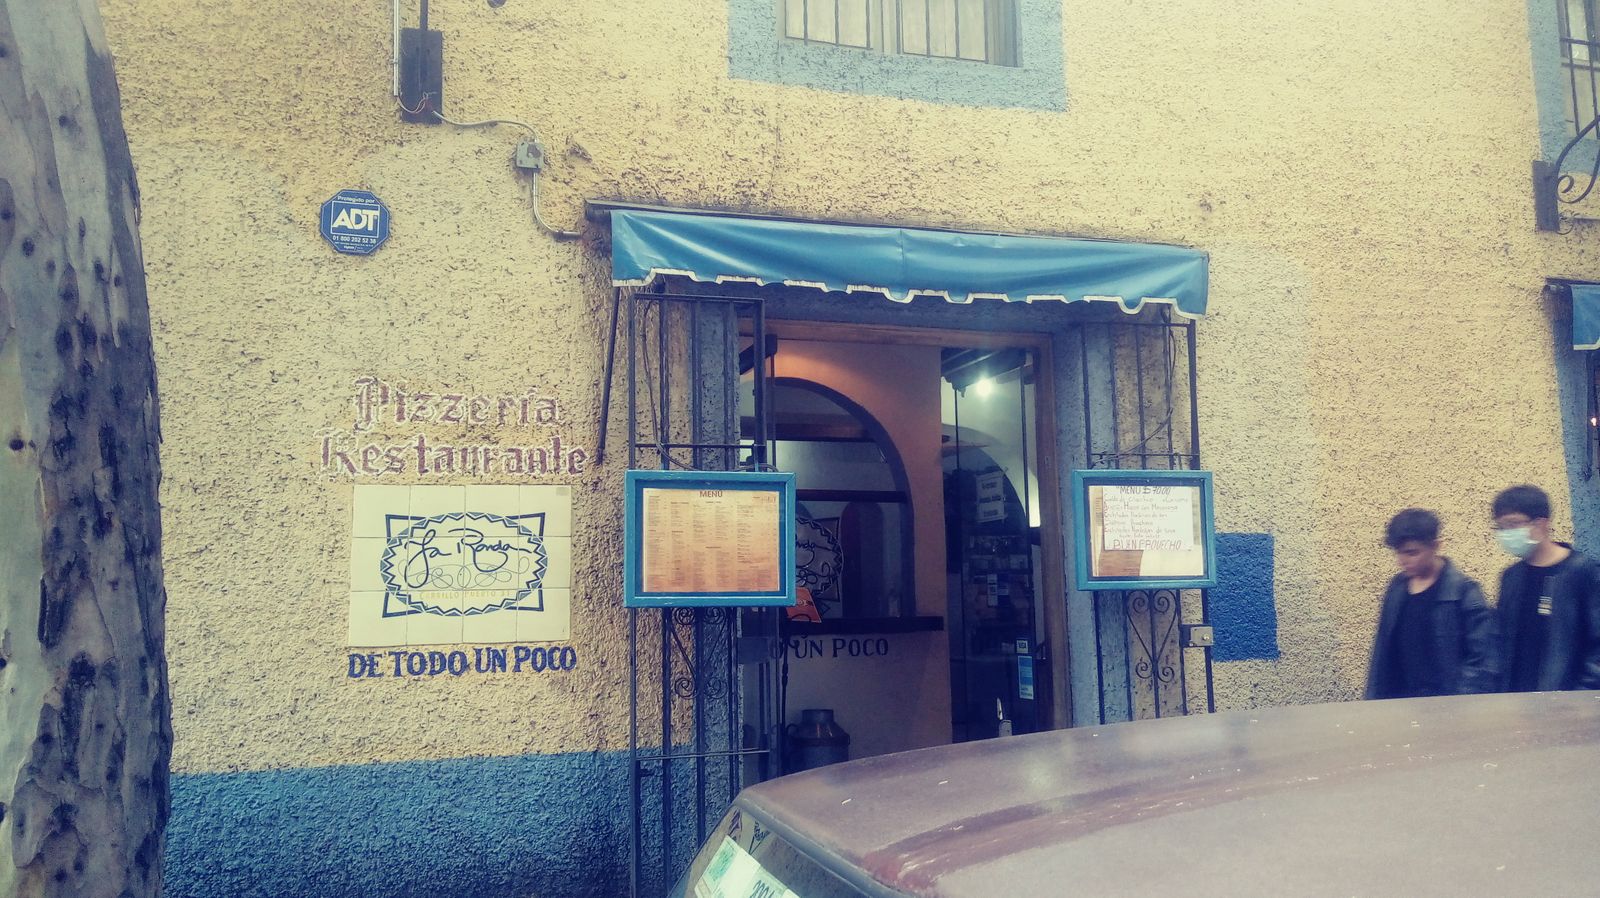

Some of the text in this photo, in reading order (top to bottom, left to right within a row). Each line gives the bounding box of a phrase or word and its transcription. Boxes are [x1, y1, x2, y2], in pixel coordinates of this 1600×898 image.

[331, 208, 380, 231] ADT
[315, 427, 590, 482] Restaurante
[402, 527, 533, 589] La Ronda
[347, 645, 577, 678] DE TODO UN POCO
[794, 638, 823, 659] UN
[831, 638, 890, 658] POCO
